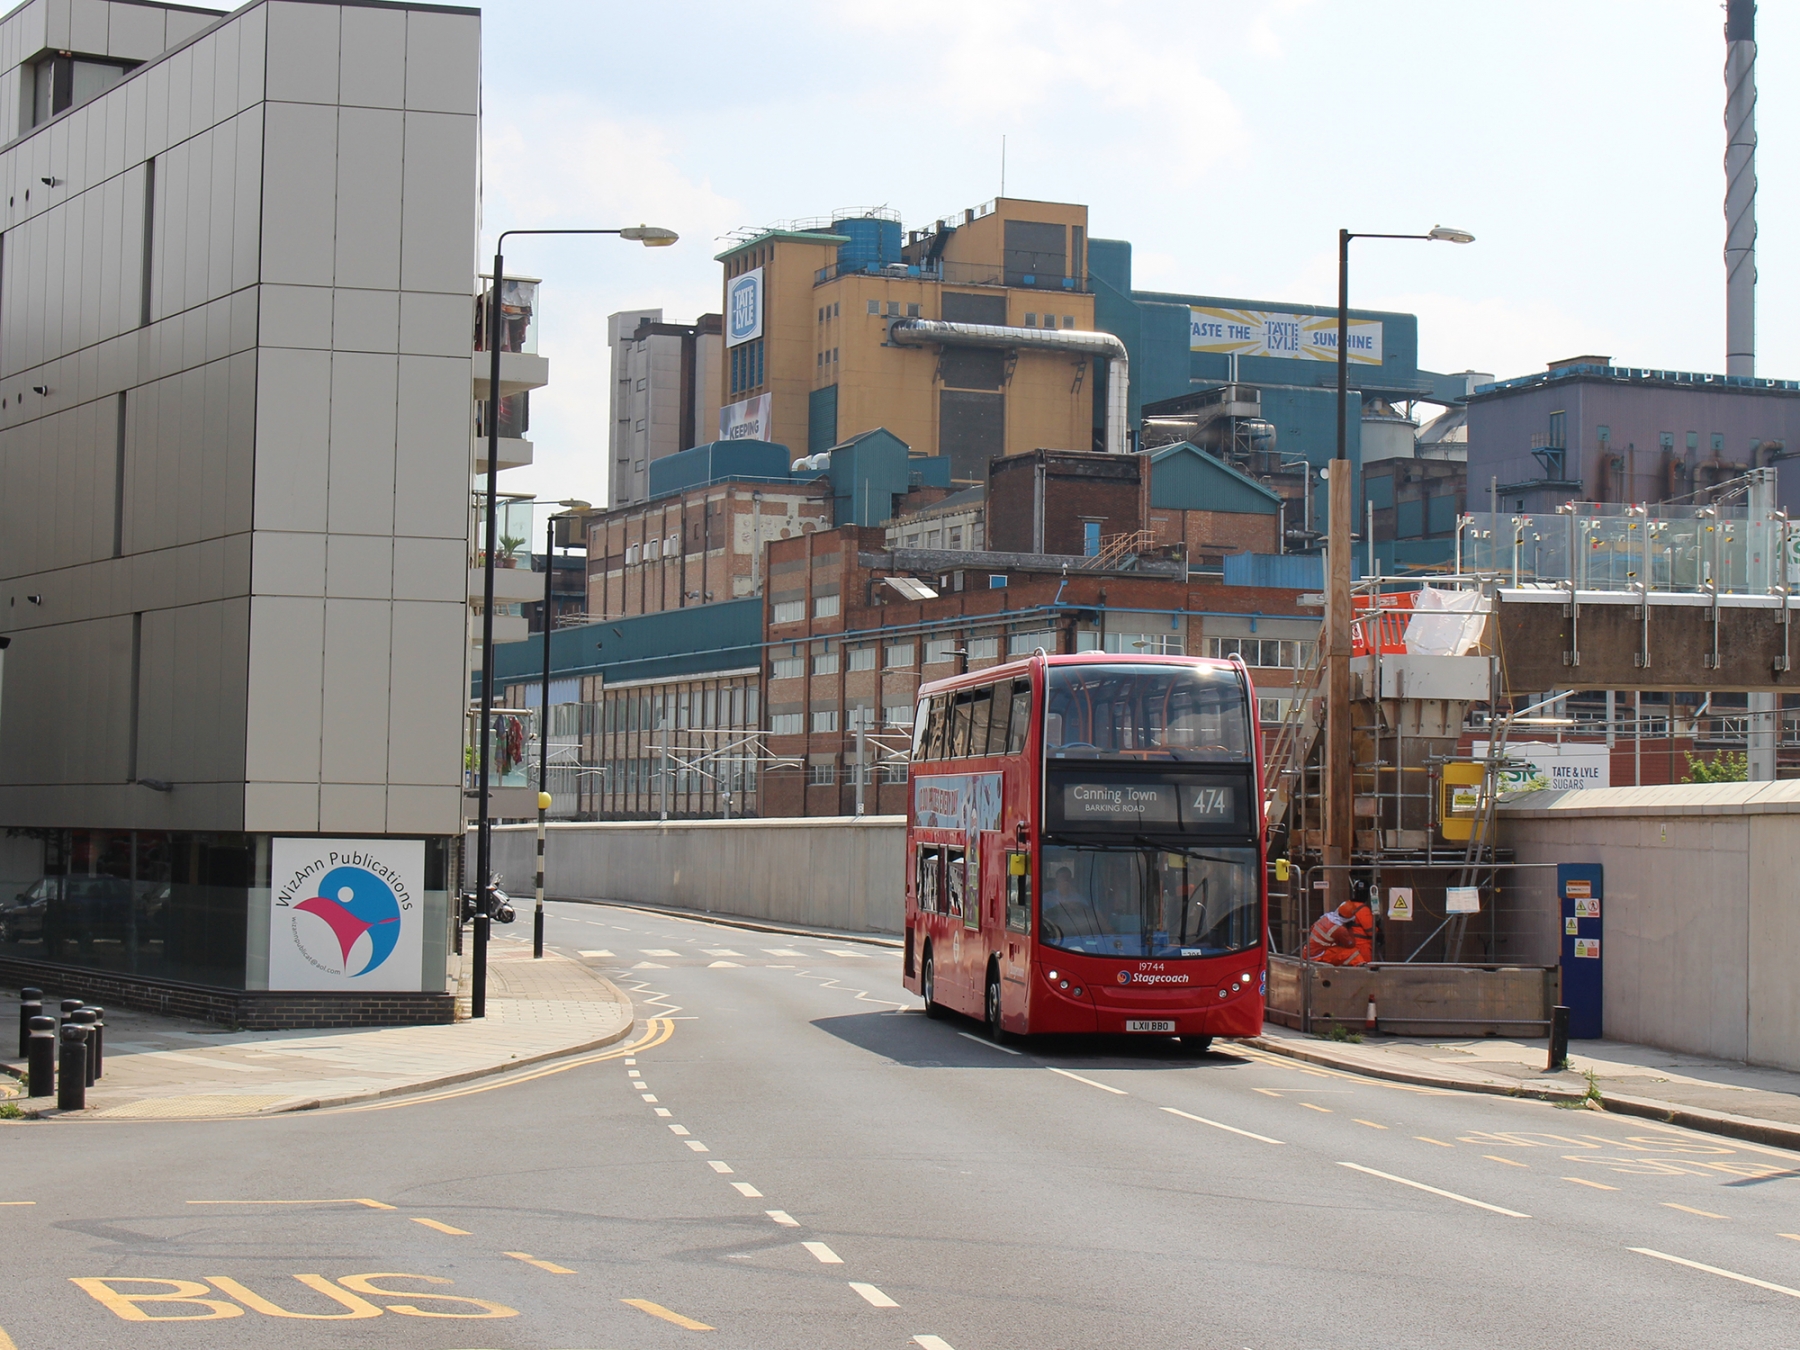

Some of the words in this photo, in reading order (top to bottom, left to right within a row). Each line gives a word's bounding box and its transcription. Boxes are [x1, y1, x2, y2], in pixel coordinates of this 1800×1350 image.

[734, 285, 754, 310] TATE
[735, 305, 754, 330] LYLE
[1228, 325, 1251, 339] THE
[1264, 321, 1298, 336] TATE
[1268, 335, 1298, 351] LYLE
[1313, 331, 1373, 349] SUNHINE
[729, 419, 759, 440] KEEPING
[1552, 766, 1571, 778] TATE
[1572, 767, 1579, 778] &
[1581, 767, 1599, 778] LYLE
[1552, 778, 1584, 790] SUGARS
[1073, 786, 1122, 804] Canning
[1126, 787, 1157, 801] Town
[1193, 789, 1226, 814] 474
[1085, 804, 1120, 813] BARKING
[1122, 804, 1146, 813] ROAD
[275, 859, 325, 908] WizAnn
[329, 850, 413, 911] Publications
[1139, 962, 1165, 972] 19744
[1132, 972, 1189, 985] Stagecoach
[1132, 1021, 1149, 1031] LX11
[1151, 1021, 1169, 1031] BBO
[68, 1272, 520, 1322] BUS
